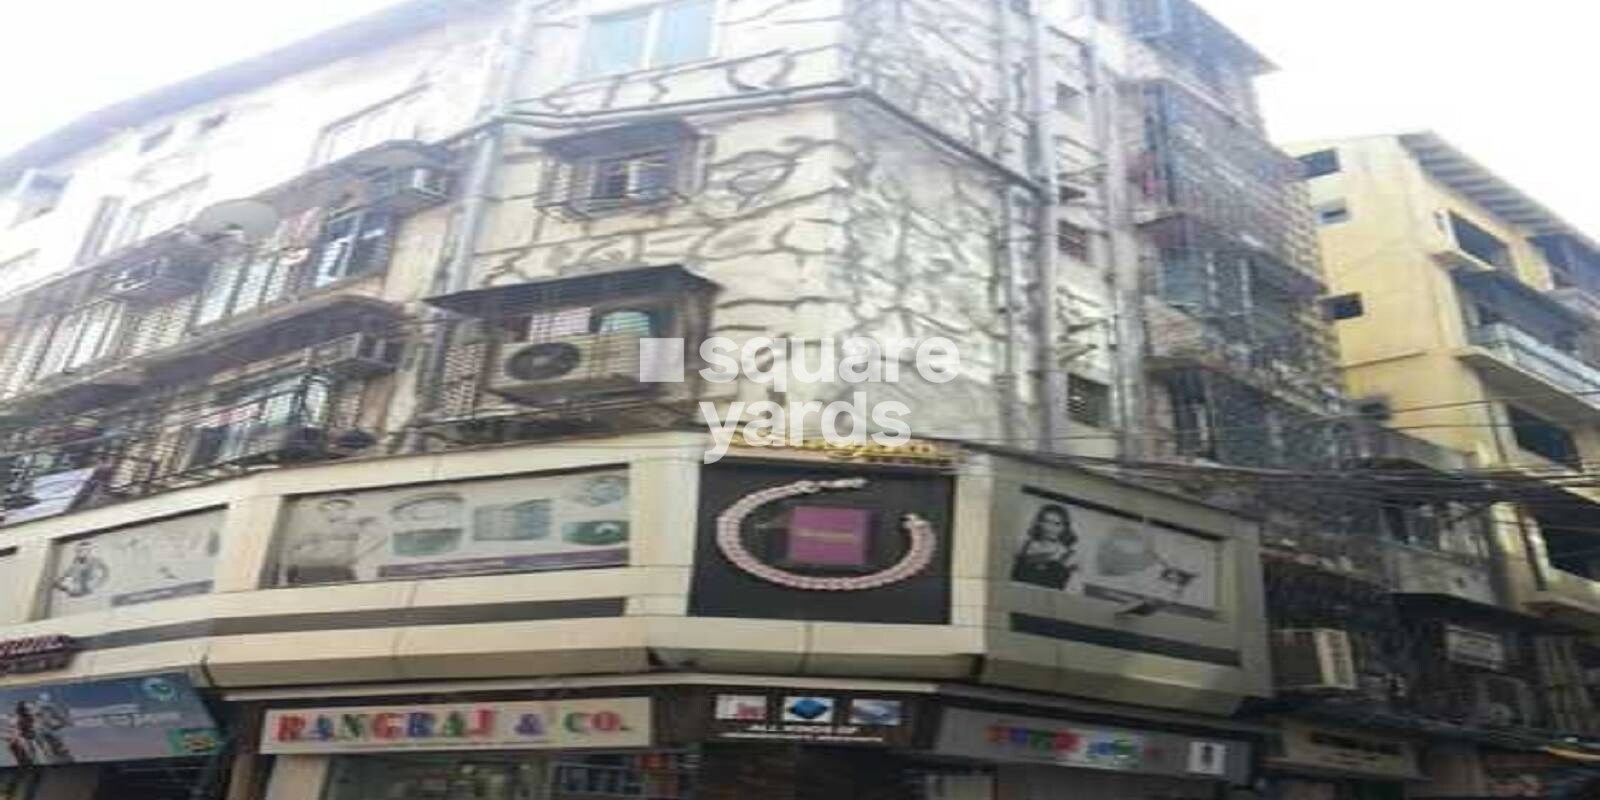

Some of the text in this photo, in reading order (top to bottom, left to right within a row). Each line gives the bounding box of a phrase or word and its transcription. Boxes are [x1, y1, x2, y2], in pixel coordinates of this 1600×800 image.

[276, 708, 633, 743] RANGRAJ & CO.
